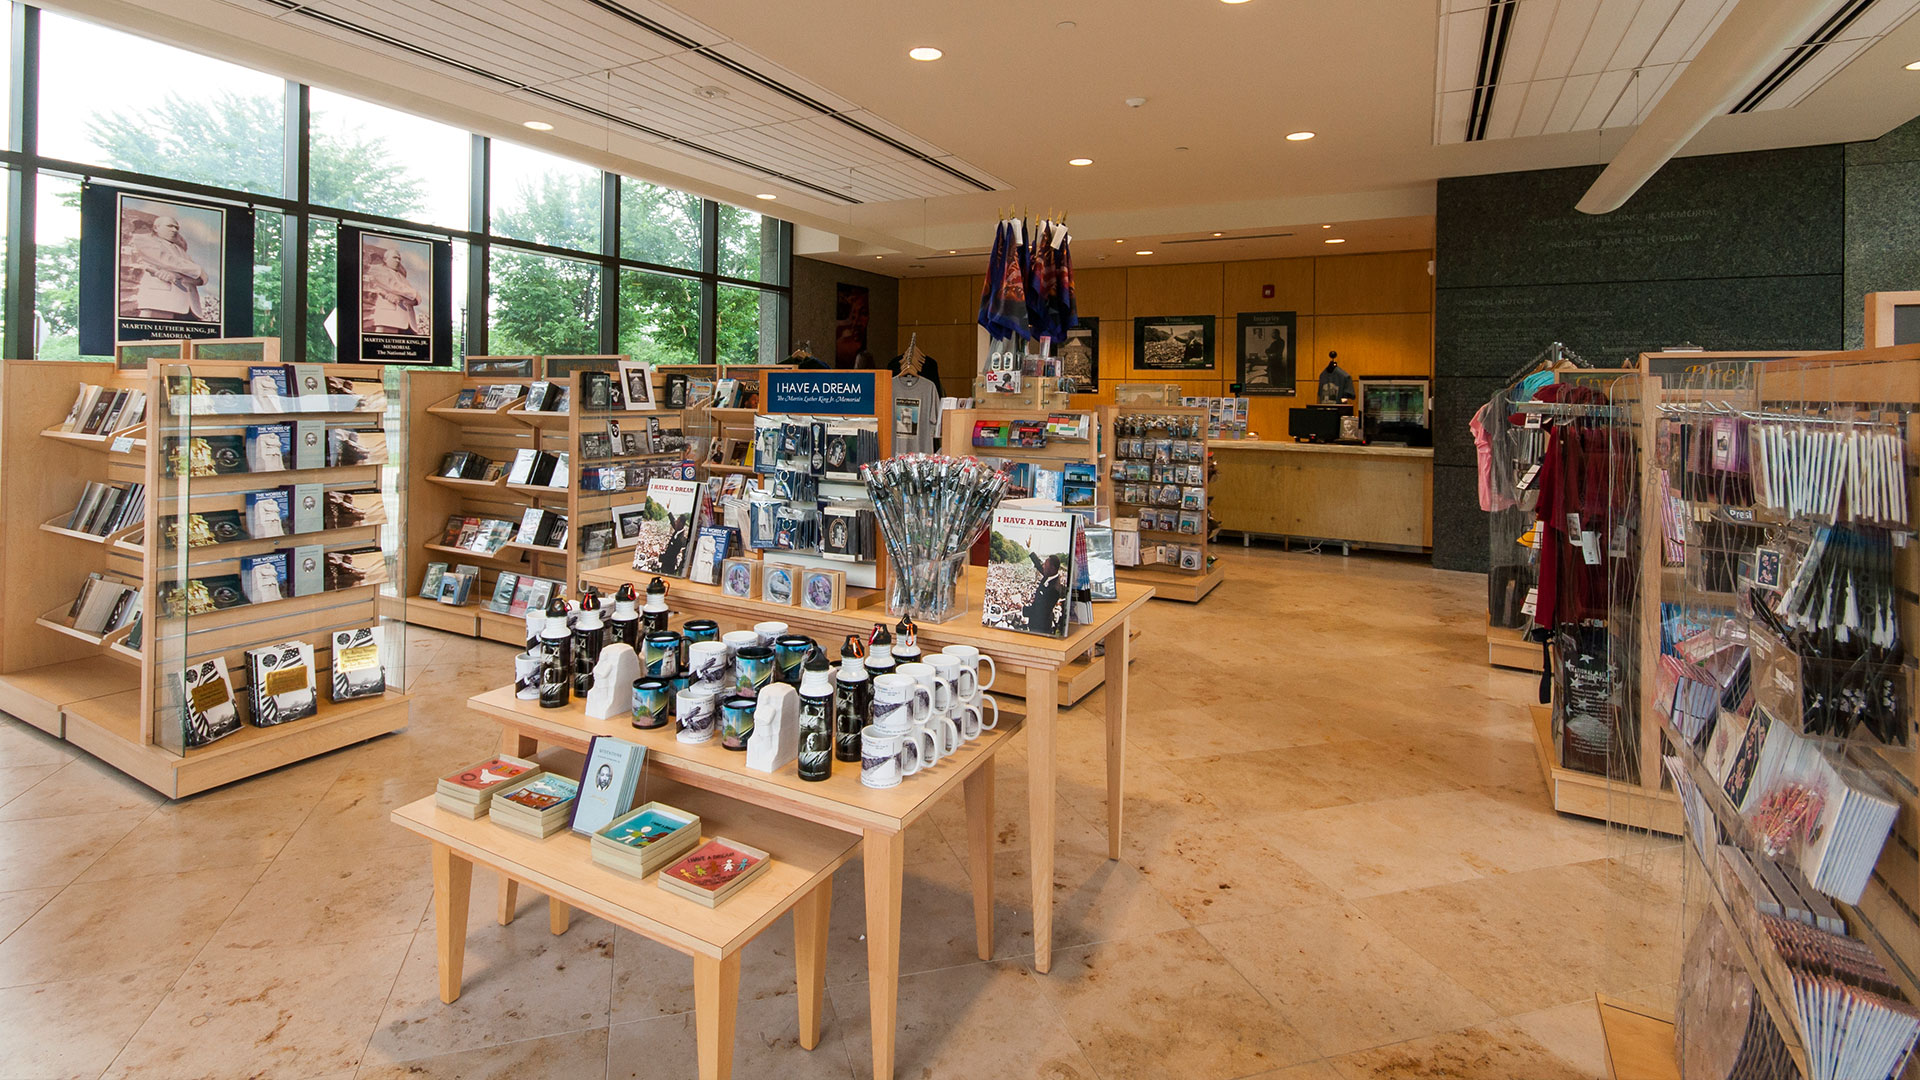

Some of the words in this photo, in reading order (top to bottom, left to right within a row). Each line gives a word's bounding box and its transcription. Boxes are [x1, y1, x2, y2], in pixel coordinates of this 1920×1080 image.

[1660, 233, 1702, 243] OBAMA
[121, 323, 153, 331] MARTIN
[154, 324, 185, 332] LUTHER
[186, 326, 207, 335] KING,
[151, 331, 193, 340] MEMORIAL
[987, 374, 998, 382] DC
[776, 382, 780, 393] I
[781, 382, 810, 393] HAVE
[811, 382, 821, 393] A
[822, 382, 862, 394] DREAM
[803, 395, 818, 403] Luther
[818, 395, 830, 404] King
[675, 486, 695, 494] DREAM
[1002, 516, 1026, 525] HAVE
[1036, 519, 1067, 528] DREAM
[990, 605, 1001, 615] 50
[690, 855, 705, 863] HAVE
[713, 852, 735, 860] DREAM
